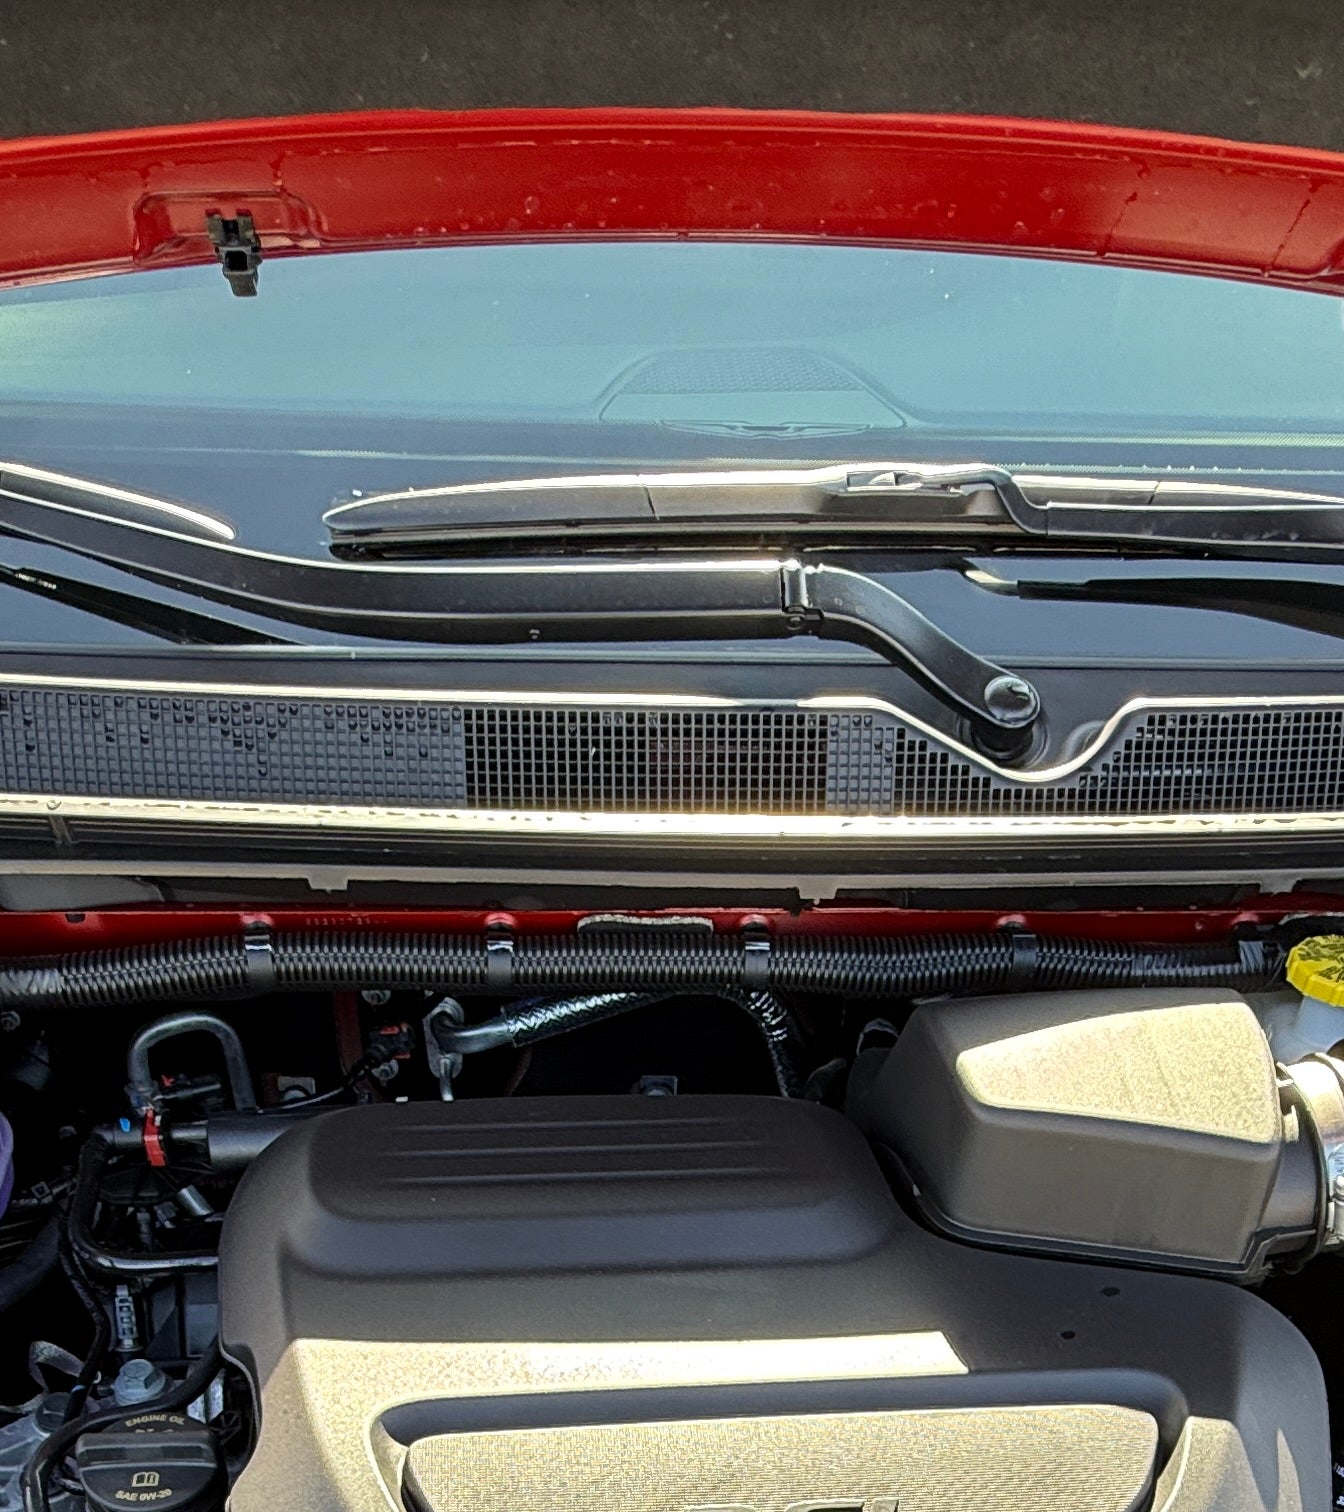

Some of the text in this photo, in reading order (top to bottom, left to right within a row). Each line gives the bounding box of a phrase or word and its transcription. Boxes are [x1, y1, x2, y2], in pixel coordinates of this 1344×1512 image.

[125, 1415, 185, 1427] ENGINE OIL
[115, 1488, 173, 1501] SAE 0W-20
